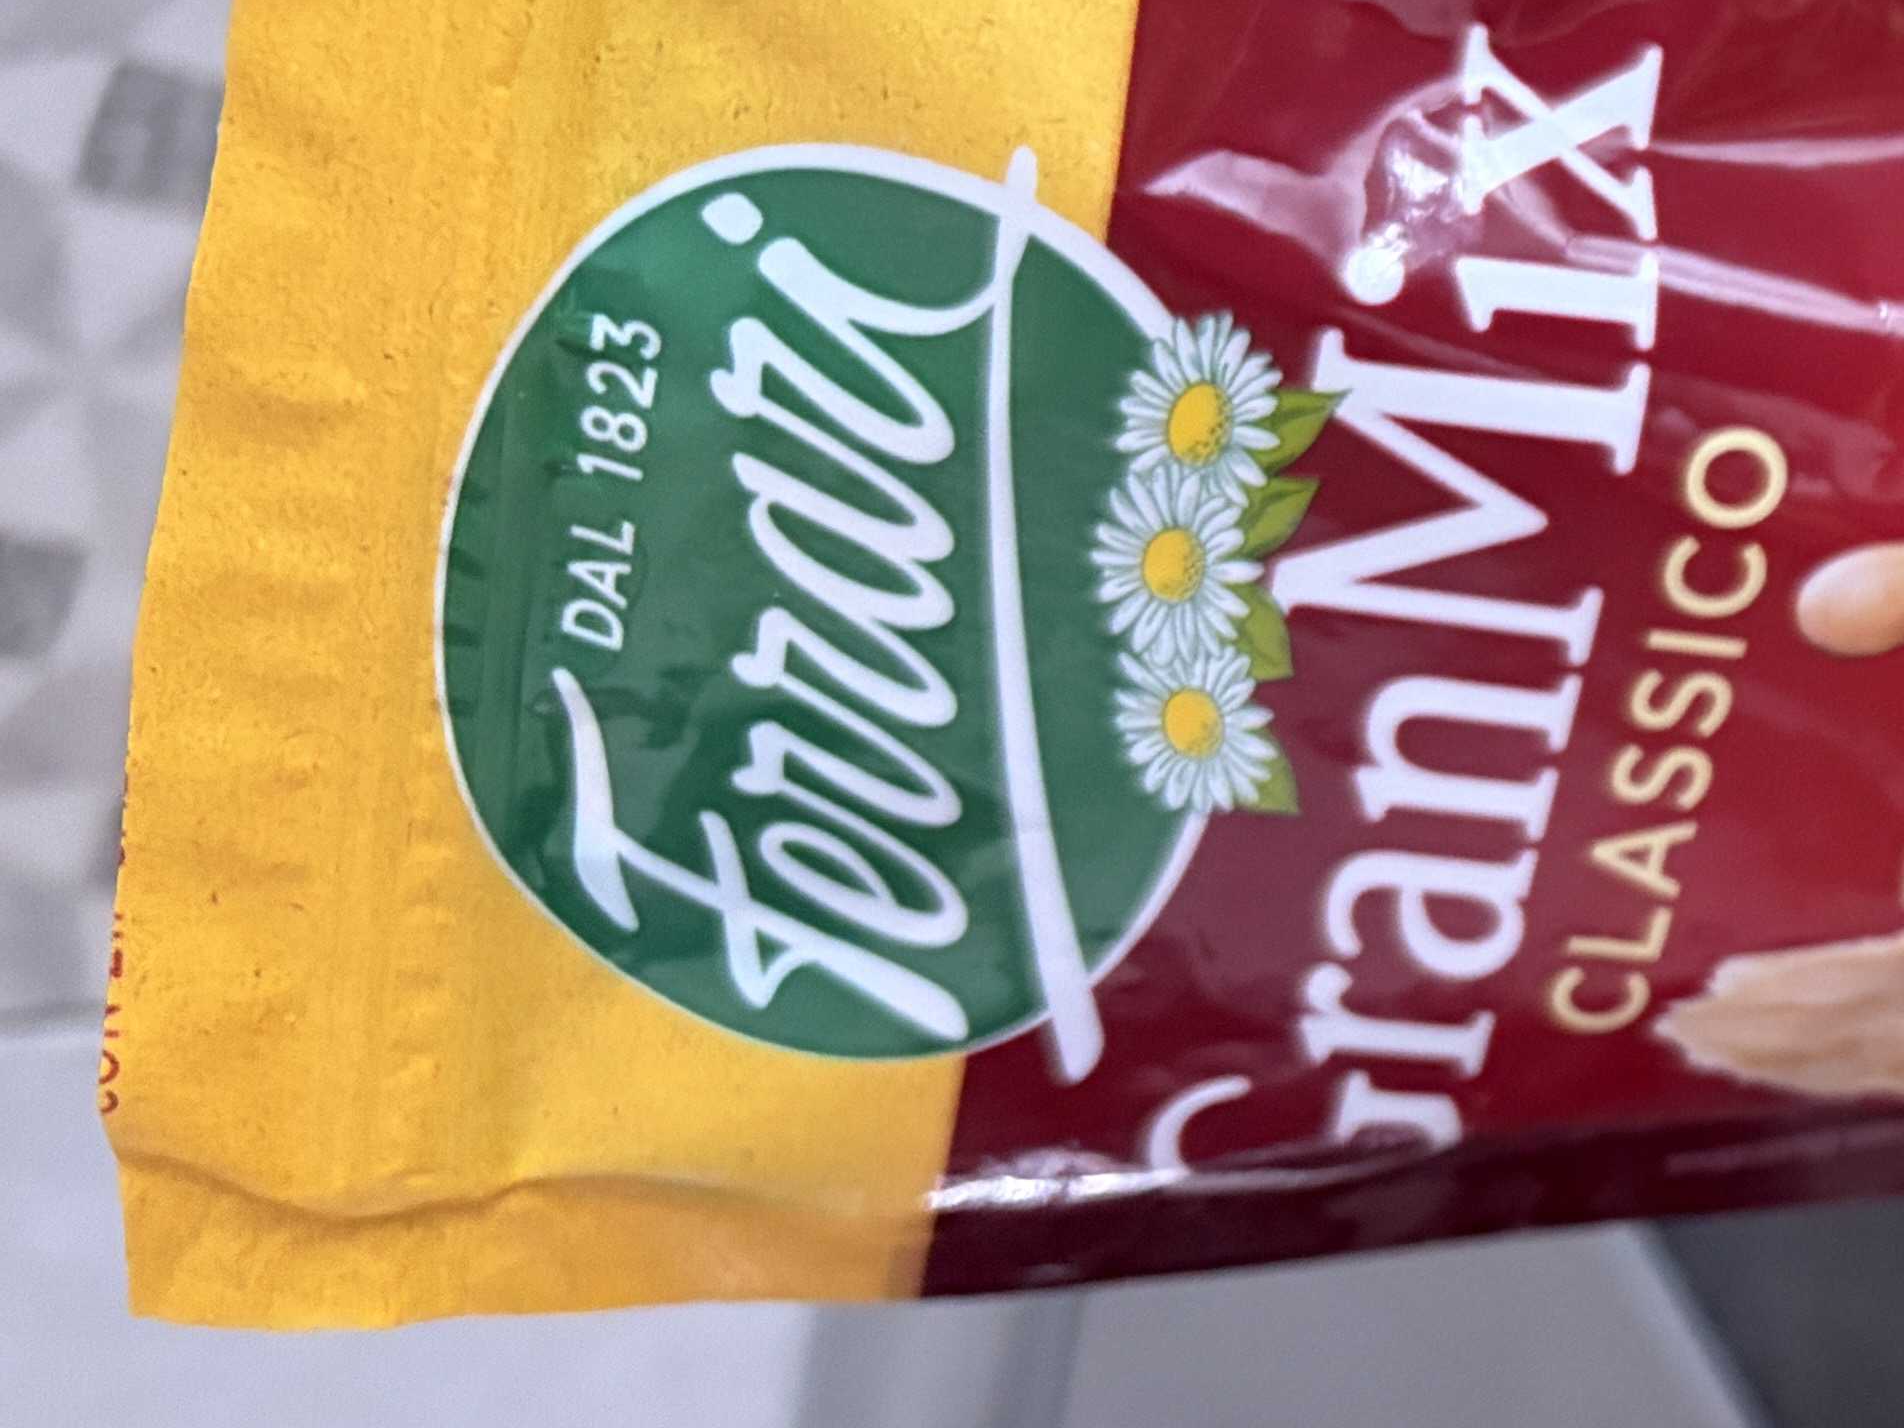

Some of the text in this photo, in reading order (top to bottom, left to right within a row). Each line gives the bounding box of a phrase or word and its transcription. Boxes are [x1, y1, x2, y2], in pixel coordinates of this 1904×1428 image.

[547, 189, 1010, 1042] Ferrari
[557, 313, 667, 653] DAL 1823
[1548, 427, 1790, 1034] CLASSICO
